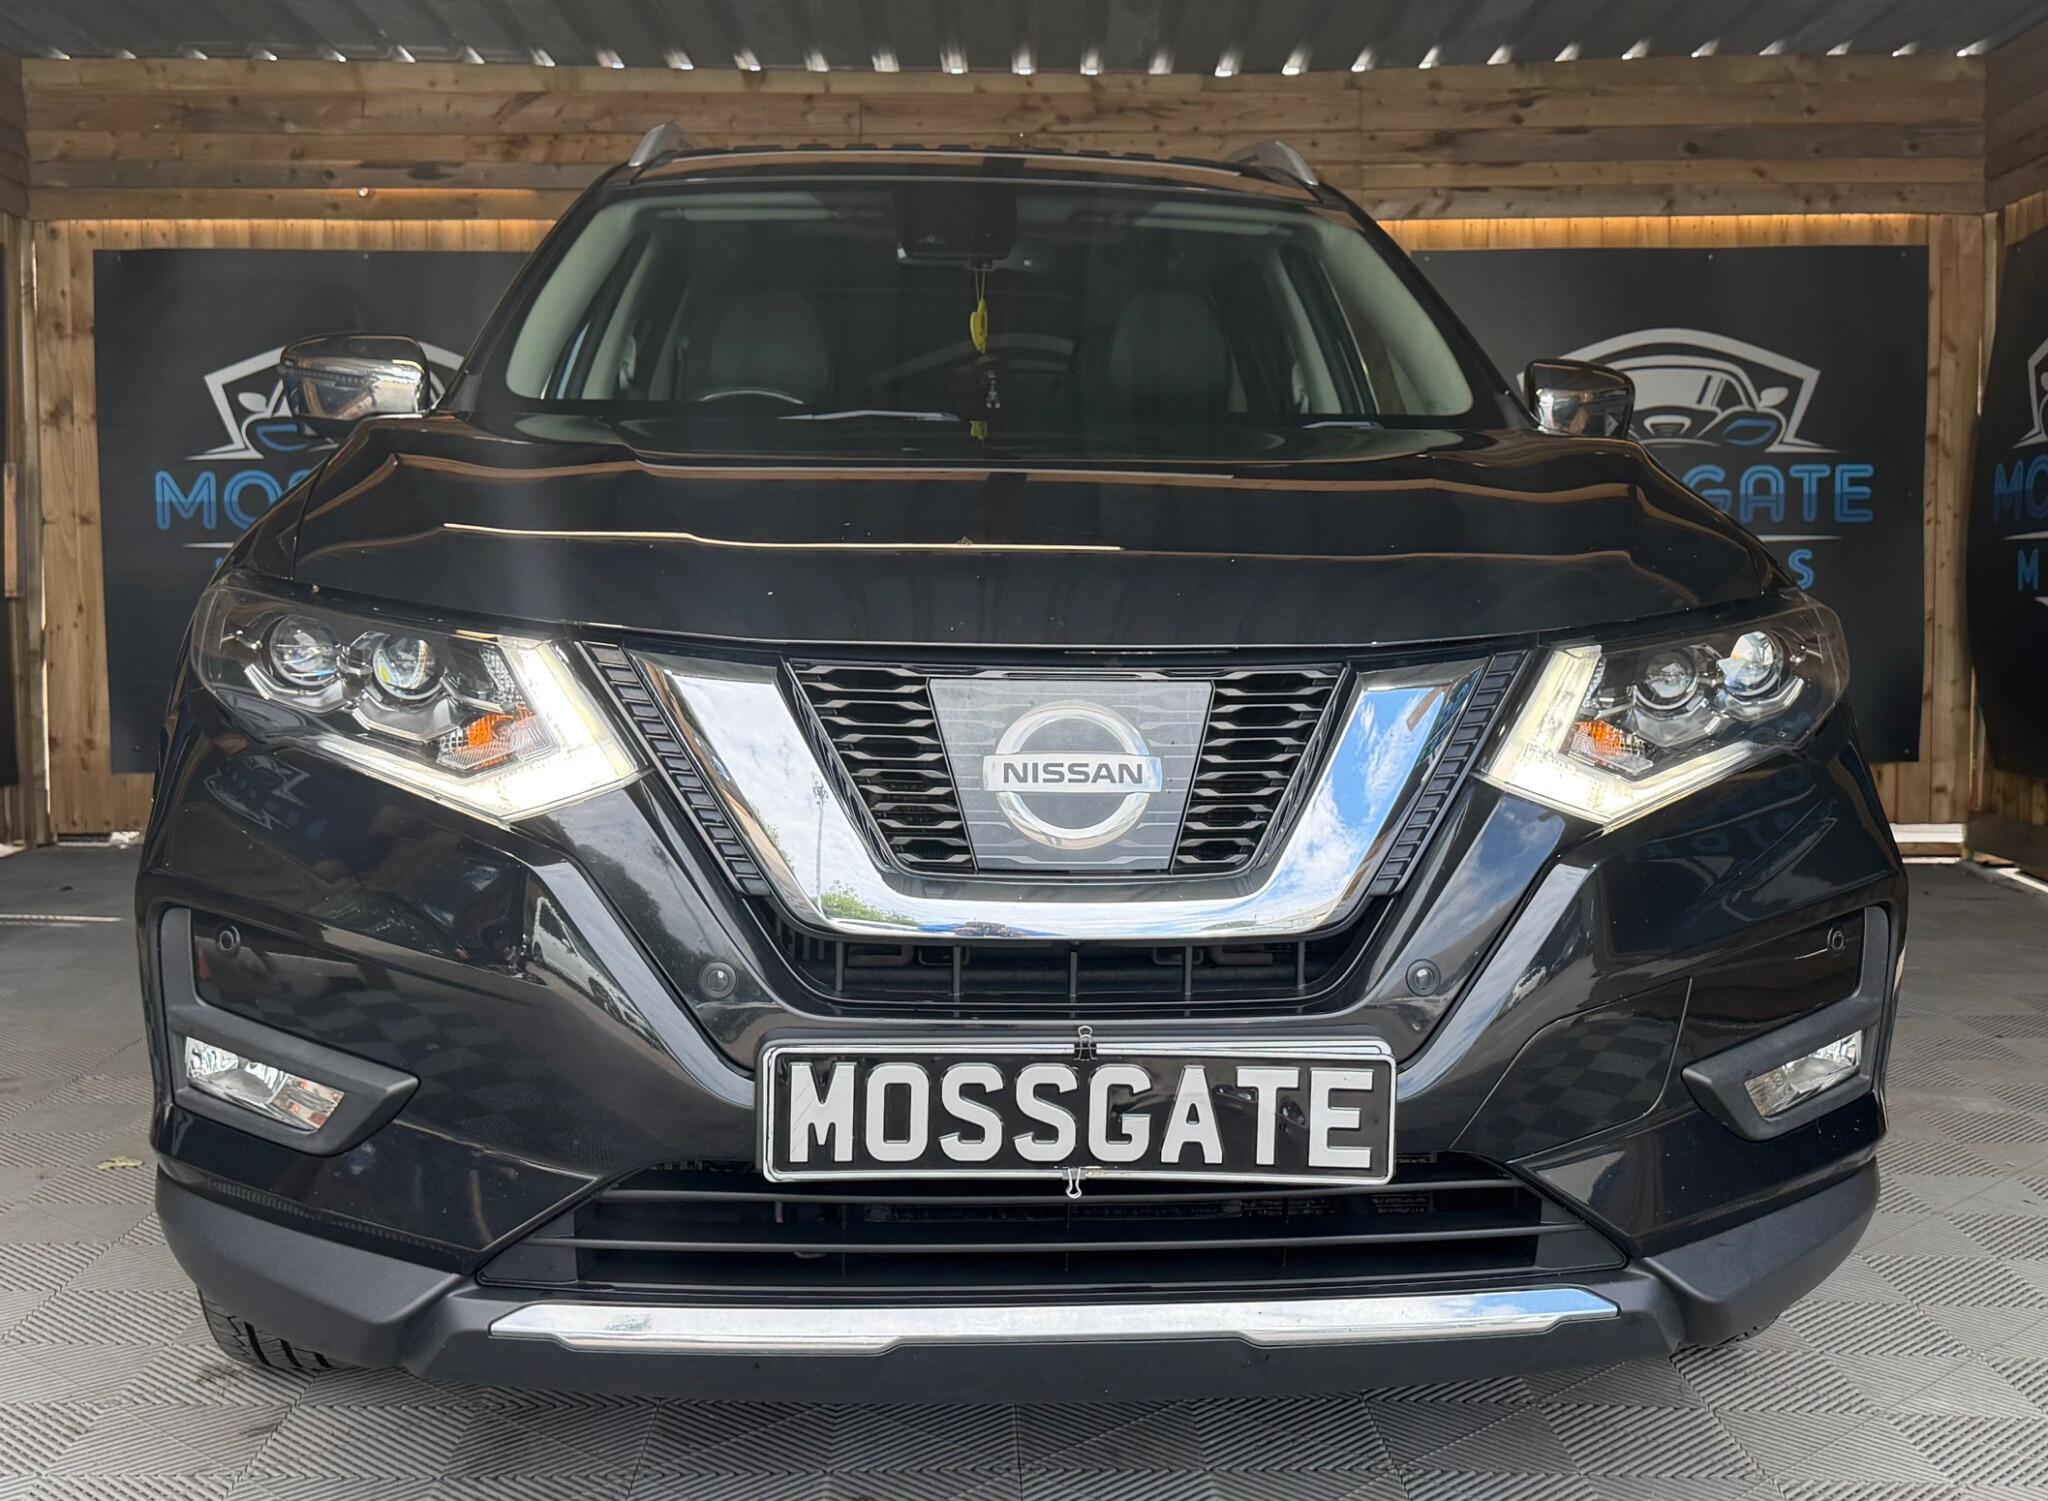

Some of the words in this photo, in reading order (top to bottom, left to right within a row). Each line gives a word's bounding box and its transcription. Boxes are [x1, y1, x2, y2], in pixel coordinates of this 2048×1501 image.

[155, 470, 313, 530] MO
[1003, 762, 1143, 784] NISSAN
[788, 1062, 1374, 1169] MOSSGATE
